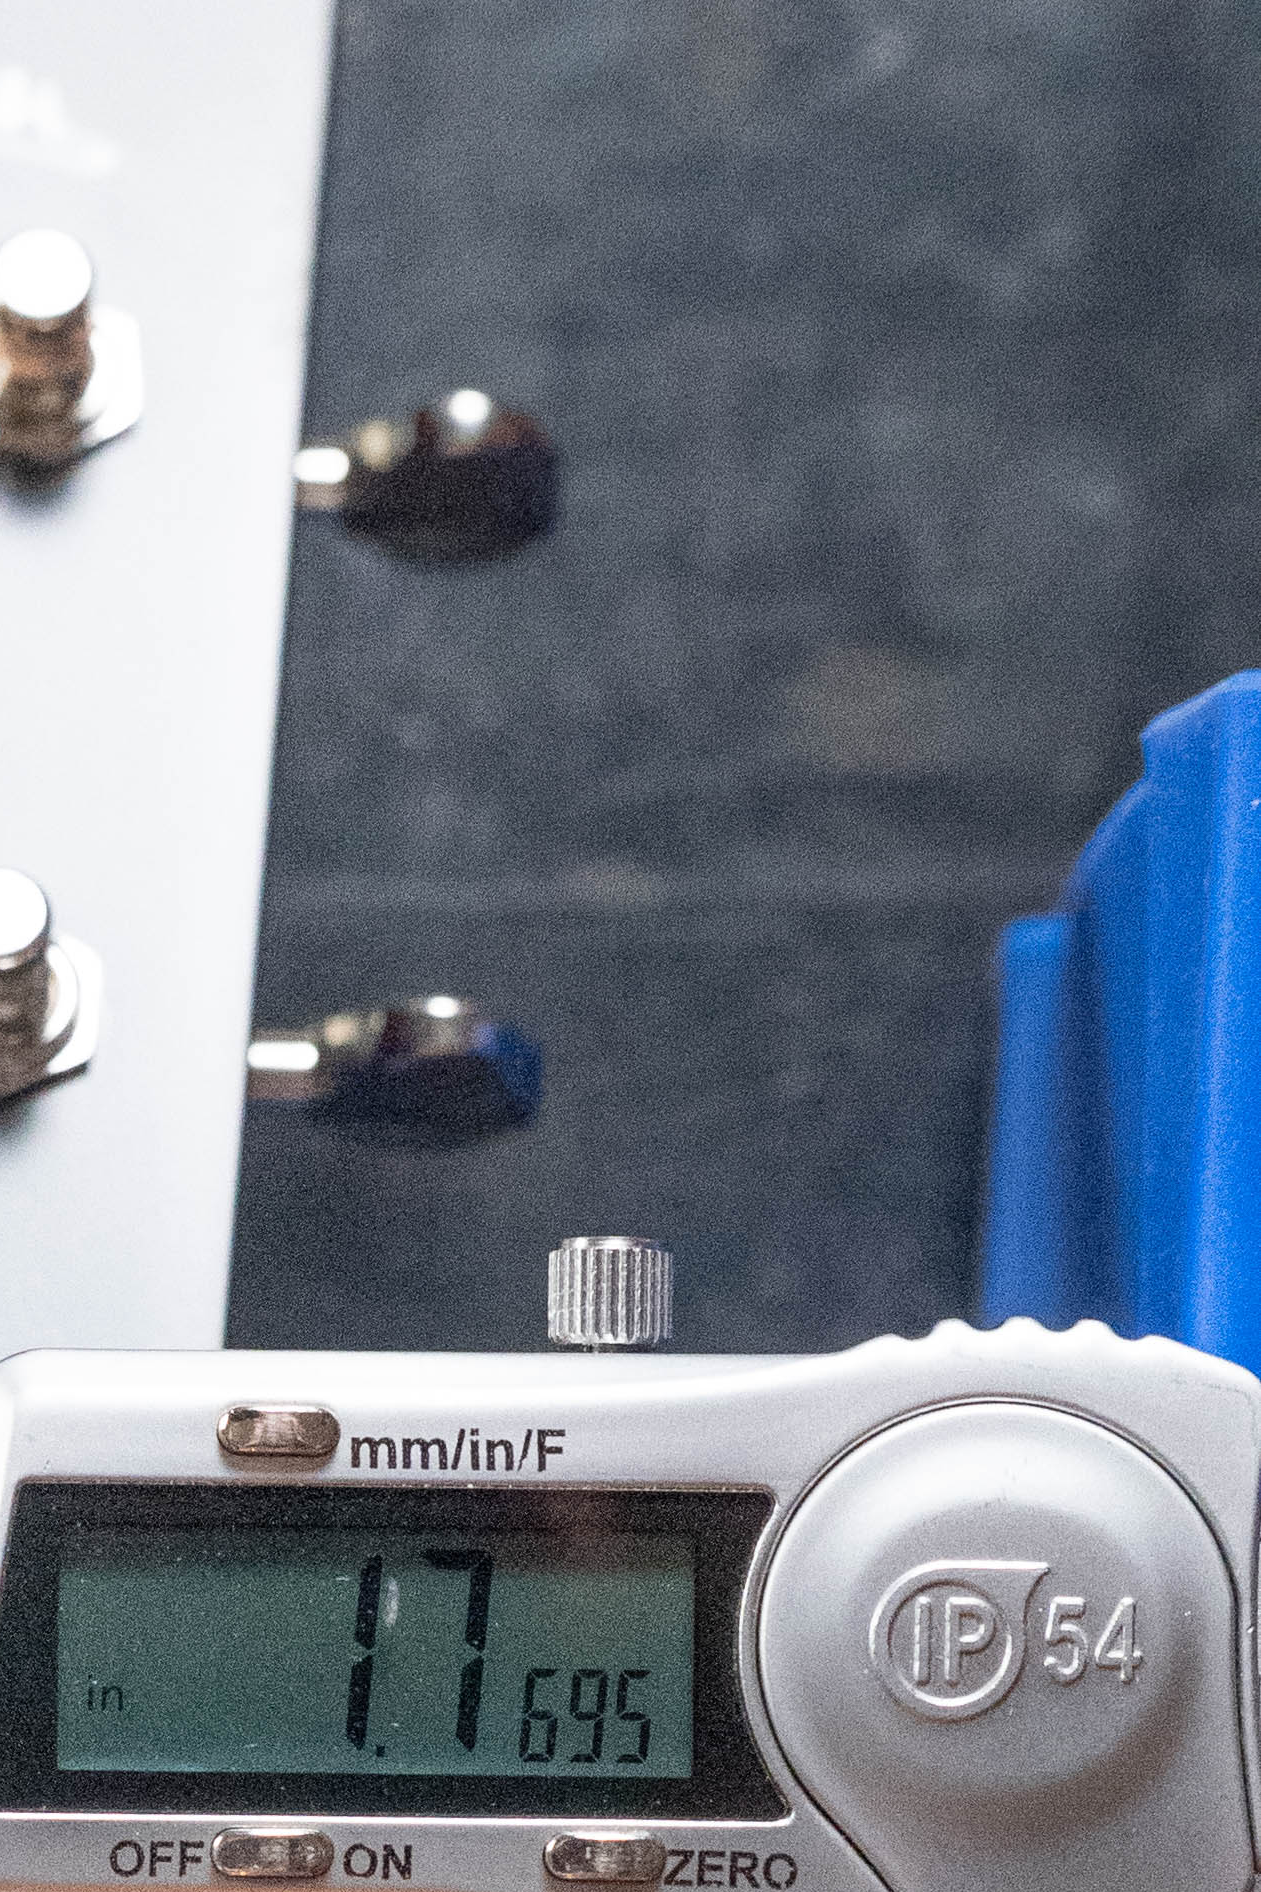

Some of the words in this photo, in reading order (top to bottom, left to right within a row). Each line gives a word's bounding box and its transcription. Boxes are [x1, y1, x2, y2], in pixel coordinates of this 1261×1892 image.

[350, 1427, 565, 1472] mm/in/F
[913, 1596, 996, 1686] IP
[1044, 1596, 1142, 1685] 54
[87, 1675, 124, 1711] in
[109, 1839, 205, 1877] OFF
[343, 1843, 413, 1880] ON
[661, 1849, 798, 1890] ZERO
